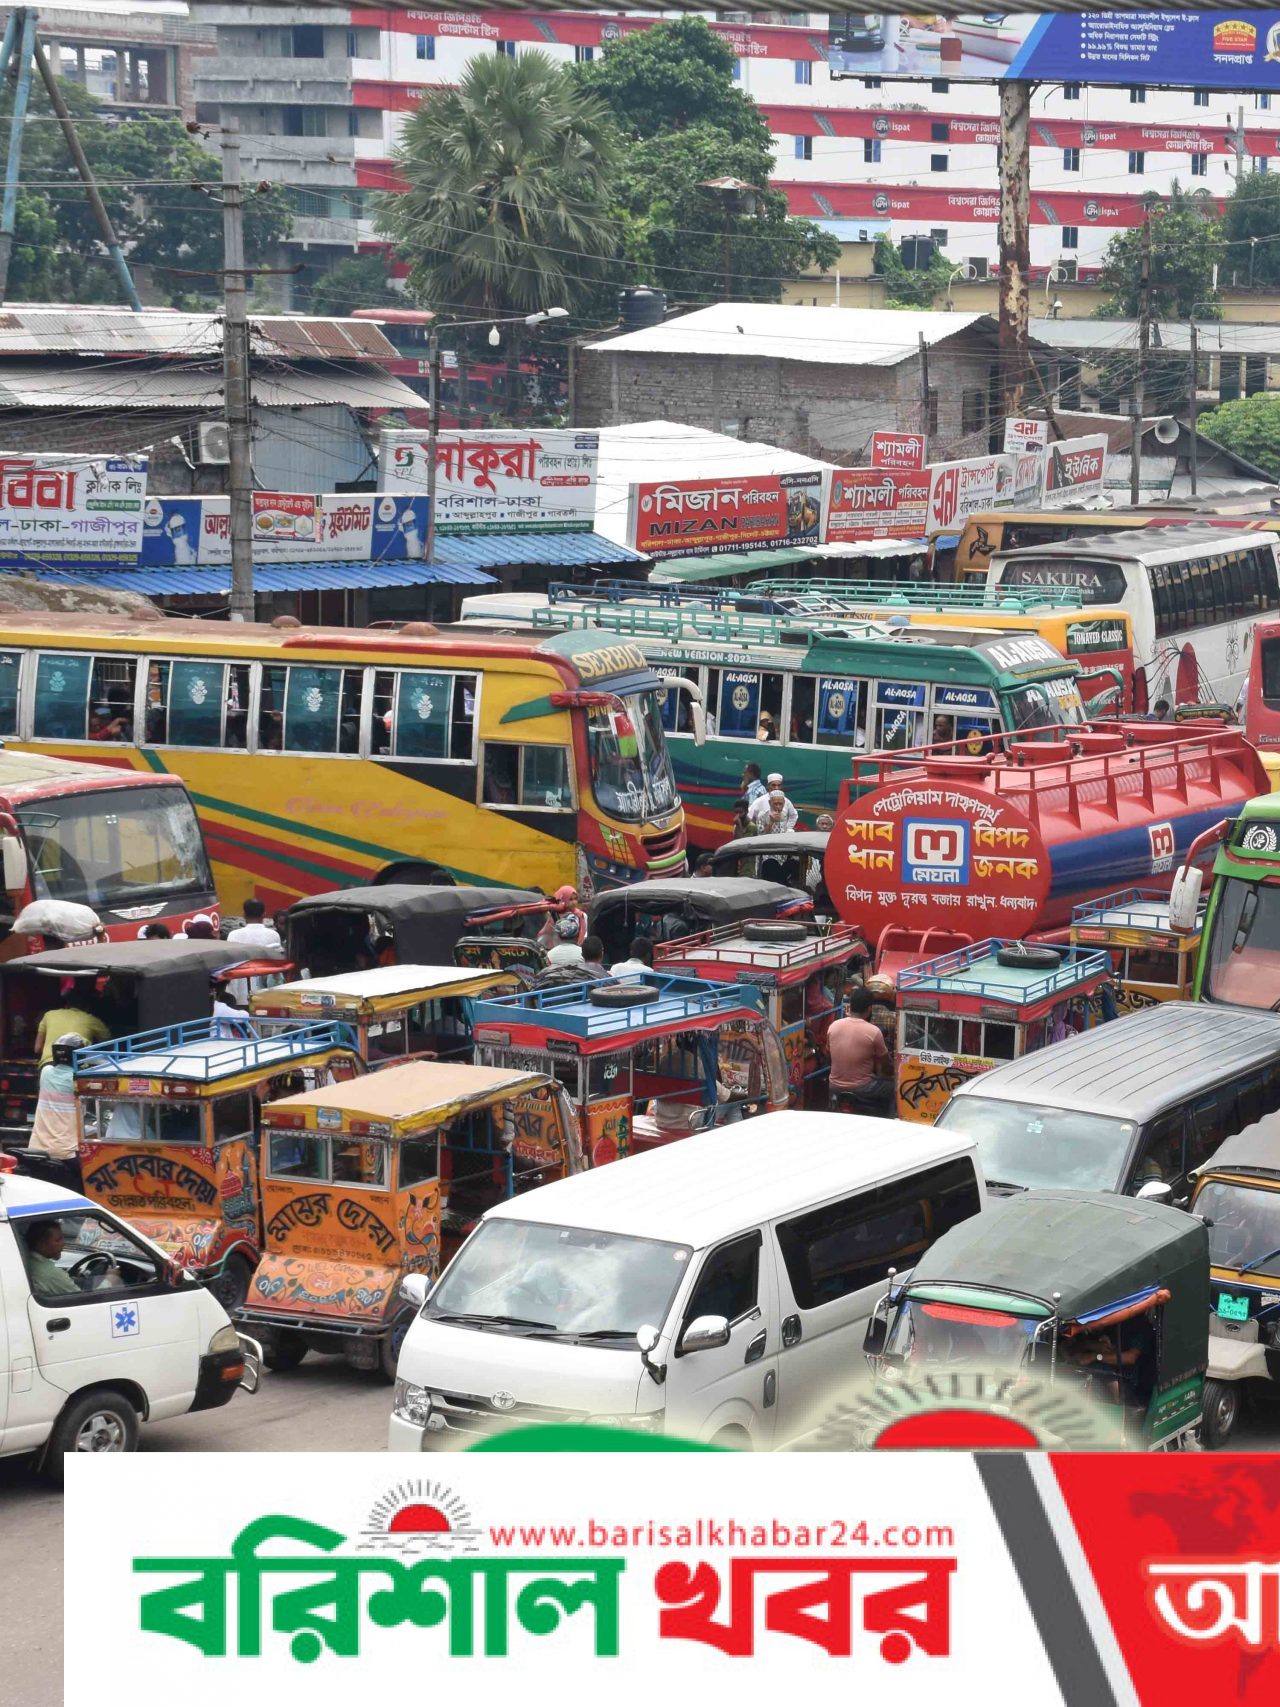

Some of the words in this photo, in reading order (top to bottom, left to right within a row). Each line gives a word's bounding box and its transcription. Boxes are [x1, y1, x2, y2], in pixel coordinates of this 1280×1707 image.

[892, 122, 911, 132] ispat
[1099, 132, 1116, 142] ispat
[891, 199, 910, 209] ispat
[1101, 206, 1119, 217] ispat
[875, 438, 921, 458] শ্যামলী
[418, 437, 544, 495] সাকুরা
[538, 454, 562, 469] পরিবহন
[1064, 454, 1100, 484] ইউনিক
[437, 495, 543, 509] বরিশাল-ঢাকা
[652, 484, 743, 516] মিজান
[742, 488, 779, 506] পরিবহন
[843, 477, 897, 509] শ্যামলী
[898, 483, 929, 500] পরিবহন
[650, 516, 738, 536] MIZAN
[1021, 571, 1102, 587] SAKURA
[1101, 629, 1123, 643] CLASSIC
[571, 643, 648, 680] SERBIC
[987, 638, 1058, 669] AL-AQSA
[726, 672, 758, 684] AL-AQSA
[822, 680, 854, 692] AL-AQSA
[884, 687, 916, 699] AL-AQSA
[945, 691, 977, 703] AL-AQSA
[885, 710, 907, 743] AL-AQSA
[873, 787, 943, 816] পেট্রোলিয়াম
[845, 819, 895, 842] সাব
[972, 819, 1030, 848] বিপদ
[847, 844, 895, 872] ধান
[972, 855, 1039, 880] জনক
[912, 867, 960, 884] মেঘনা
[845, 885, 872, 903] বিপদ
[877, 891, 897, 907] মুক্ত
[931, 893, 961, 907] বজায়
[176, 1164, 218, 1206] দোয়া
[267, 1193, 332, 1242] মায়ের
[337, 1198, 396, 1253] দোয়া
